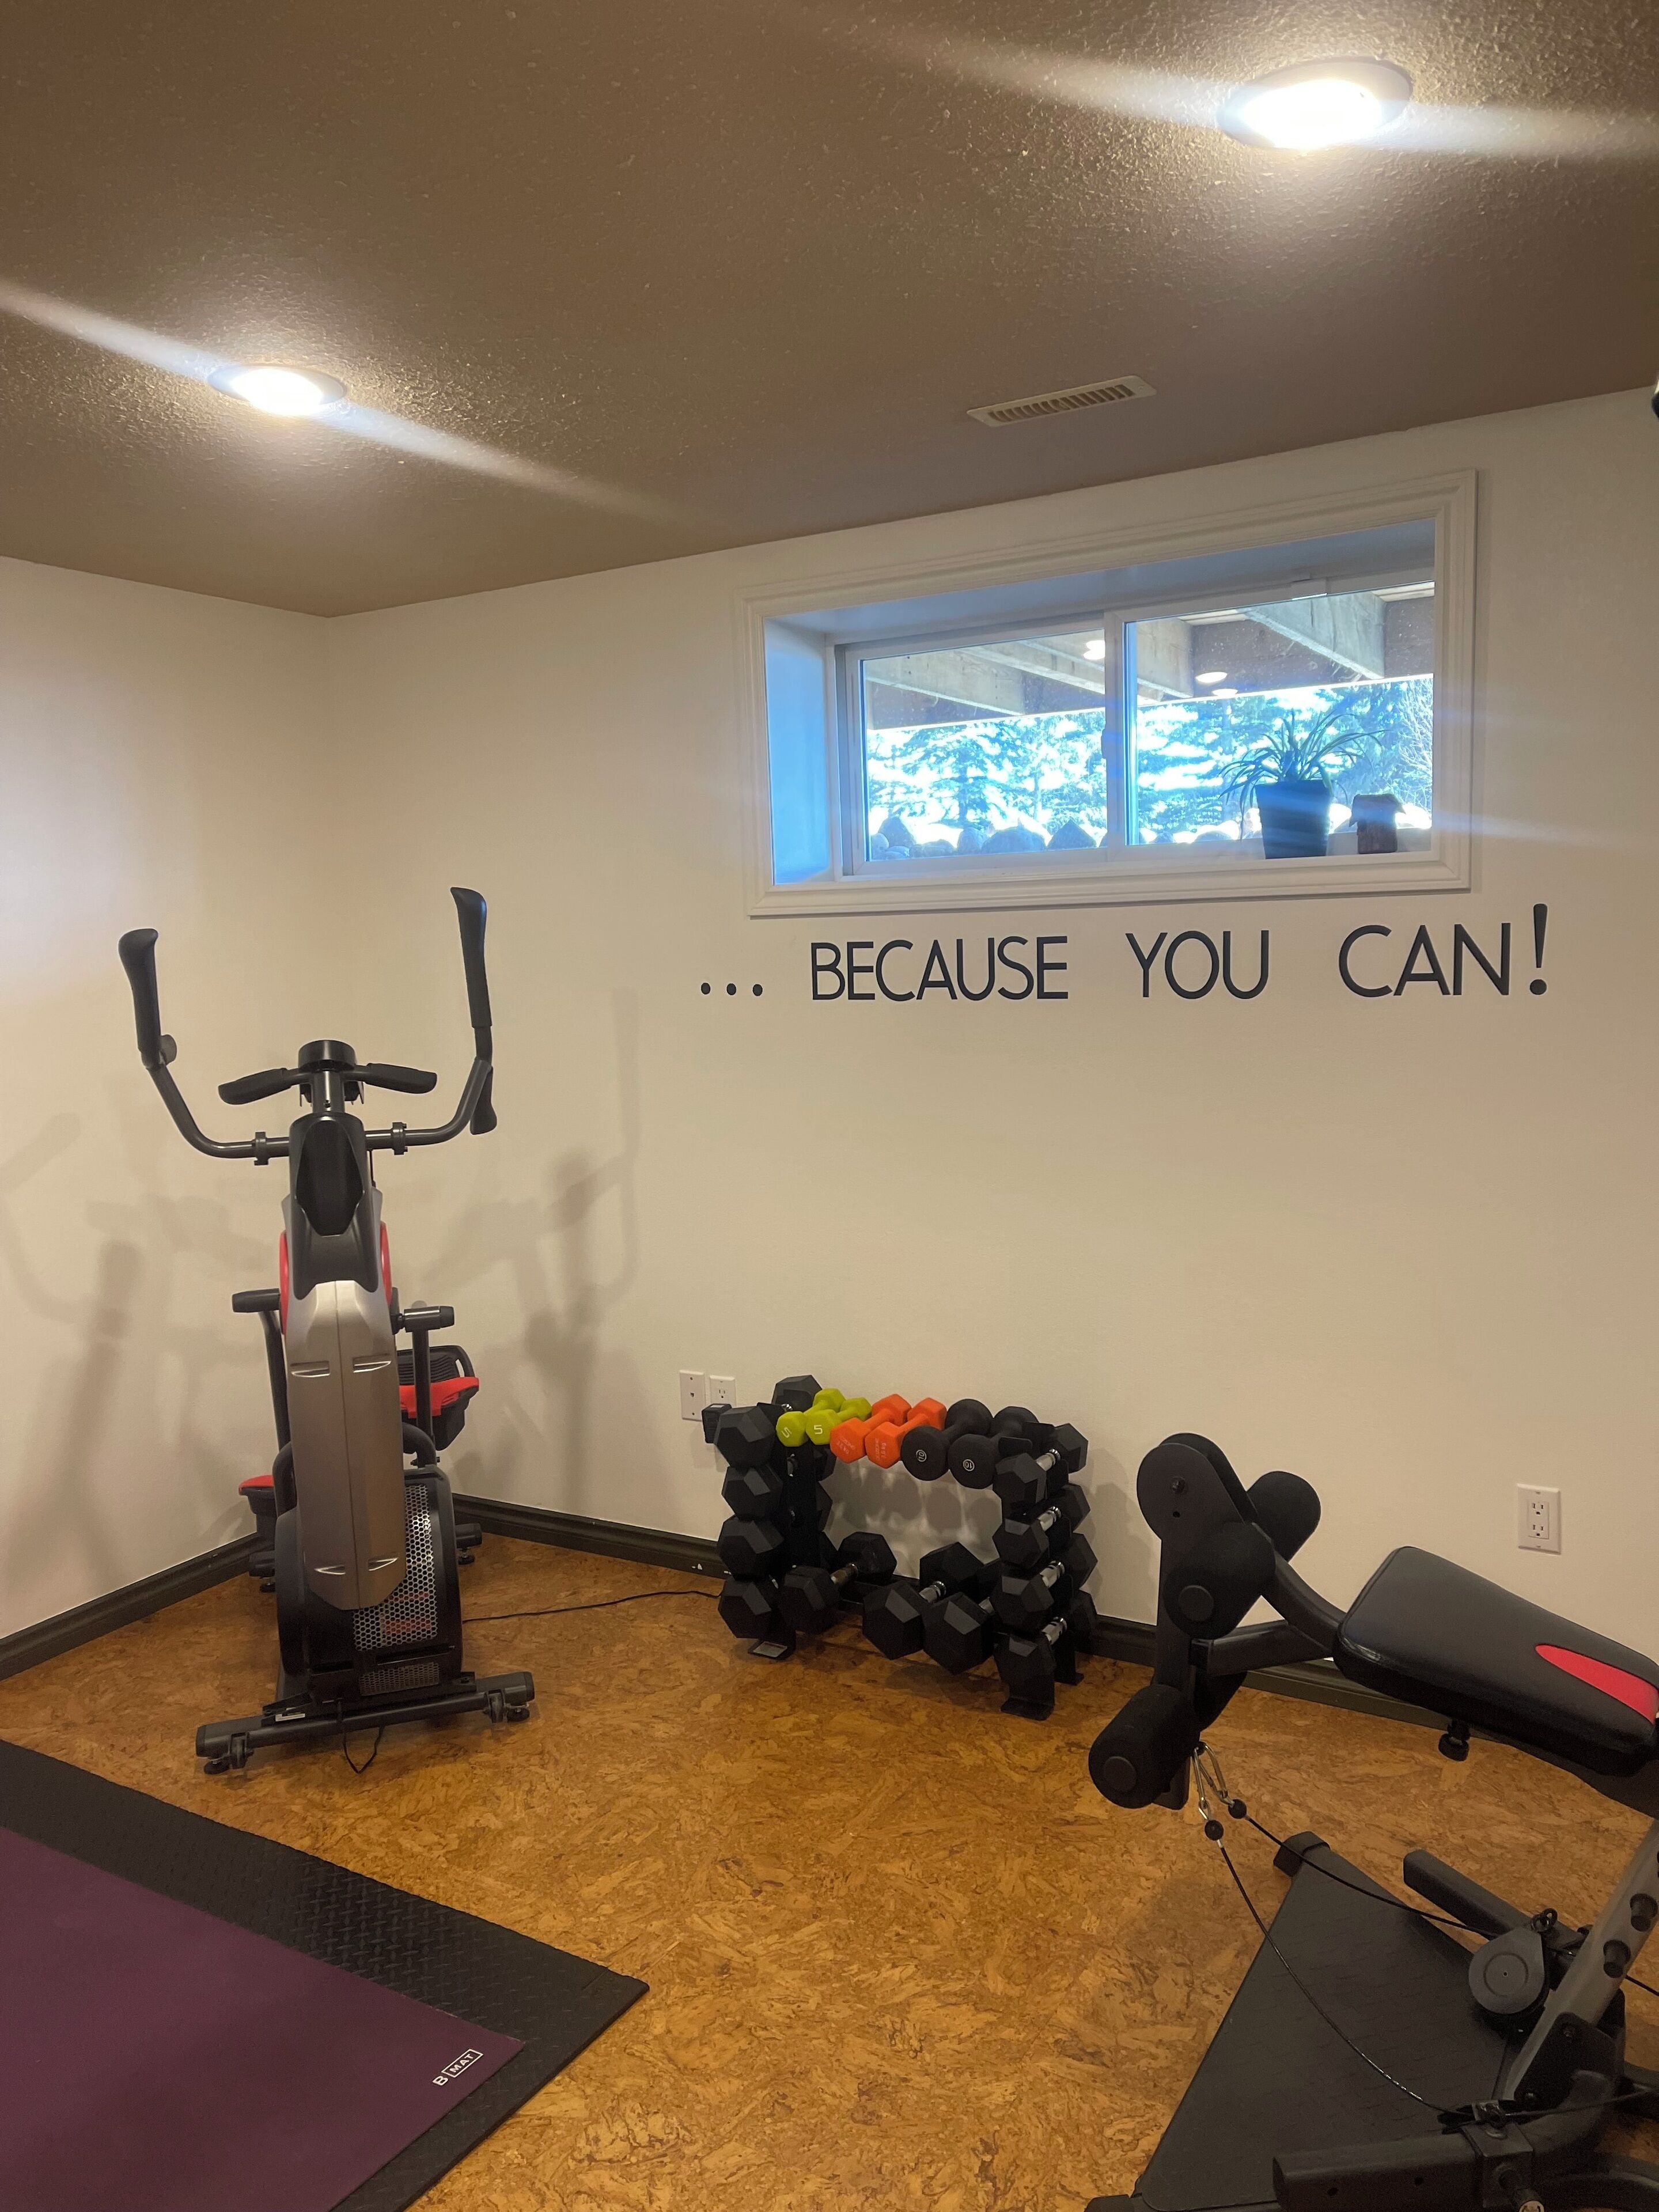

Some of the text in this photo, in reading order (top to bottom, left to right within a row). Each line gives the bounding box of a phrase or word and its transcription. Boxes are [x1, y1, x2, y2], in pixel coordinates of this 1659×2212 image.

[810, 935, 1069, 1002] BECAUSE
[1124, 929, 1270, 1000] YOU
[781, 1426, 792, 1438] 5
[813, 1424, 823, 1435] 5
[918, 1451, 925, 1460] 10
[964, 1461, 973, 1469] 10
[432, 2053, 474, 2086] B MAT
